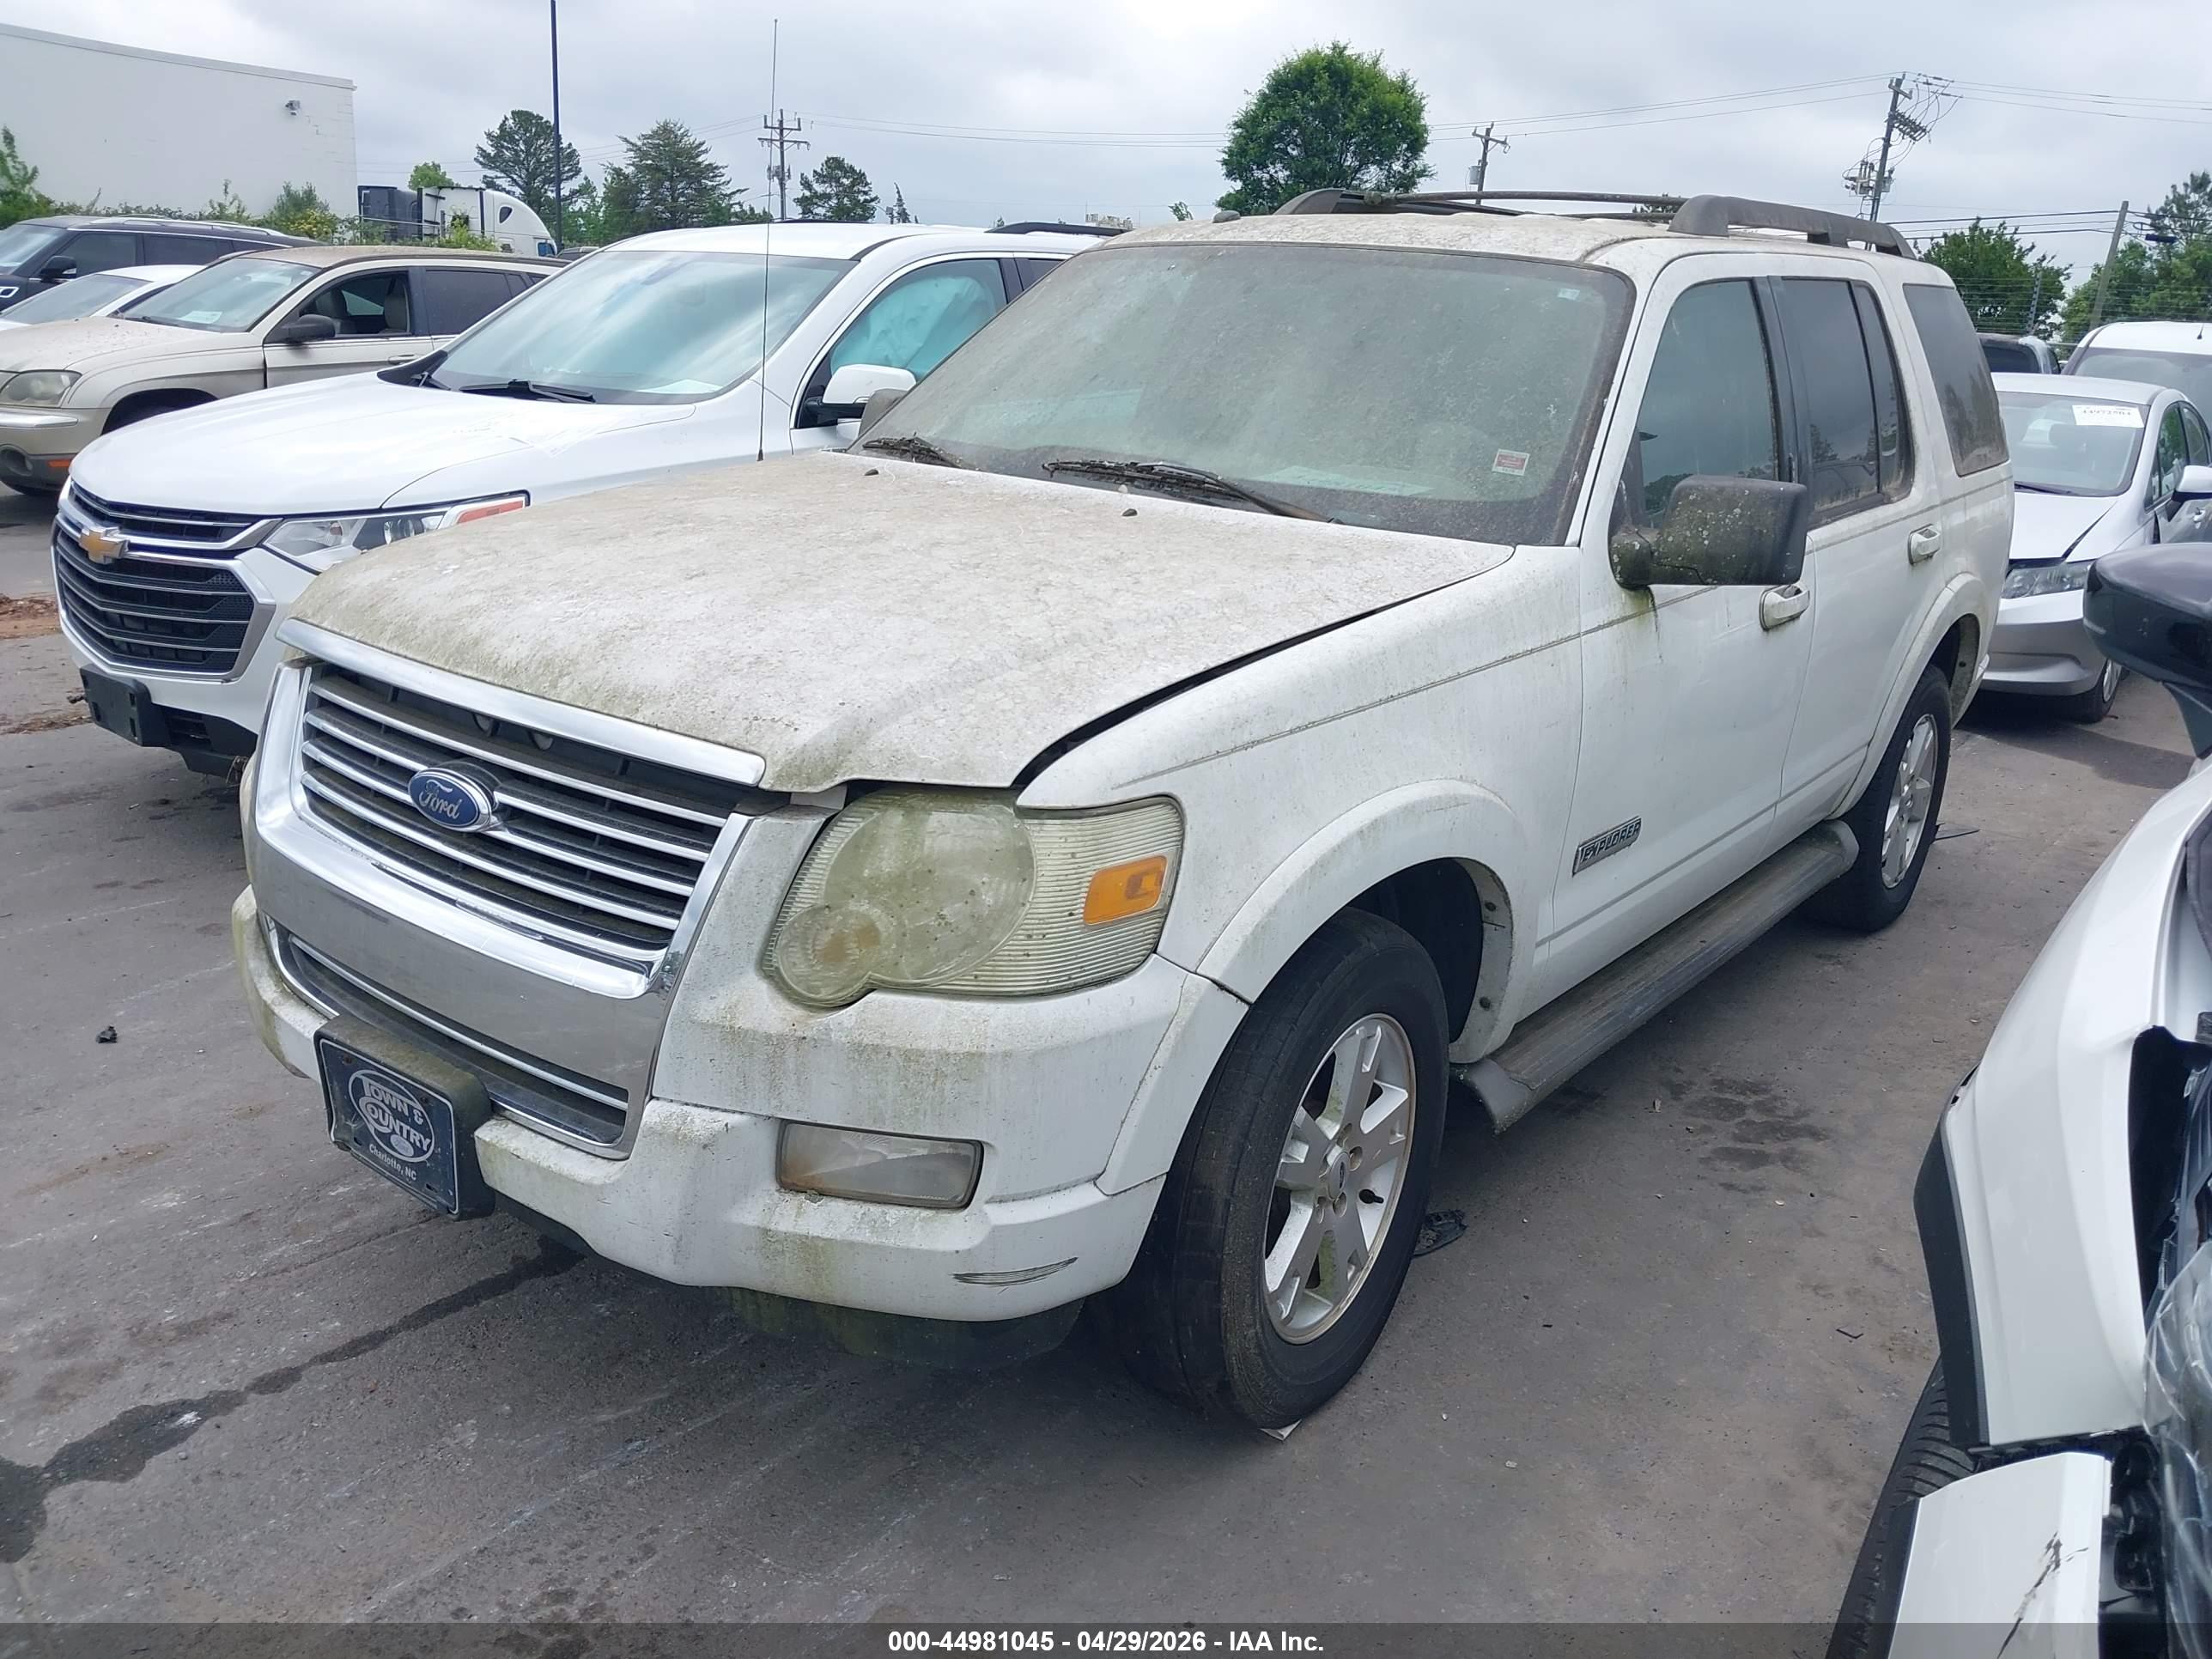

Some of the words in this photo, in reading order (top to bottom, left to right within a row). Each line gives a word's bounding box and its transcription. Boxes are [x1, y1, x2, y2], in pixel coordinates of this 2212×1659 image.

[418, 779, 463, 819] Ford
[1580, 819, 1640, 863] EXPLORER
[355, 1073, 422, 1116] TOWN
[413, 1109, 424, 1126] &
[359, 1097, 431, 1152] COUNTRY
[369, 1144, 404, 1176] Charlotte,
[405, 1168, 417, 1181] NC
